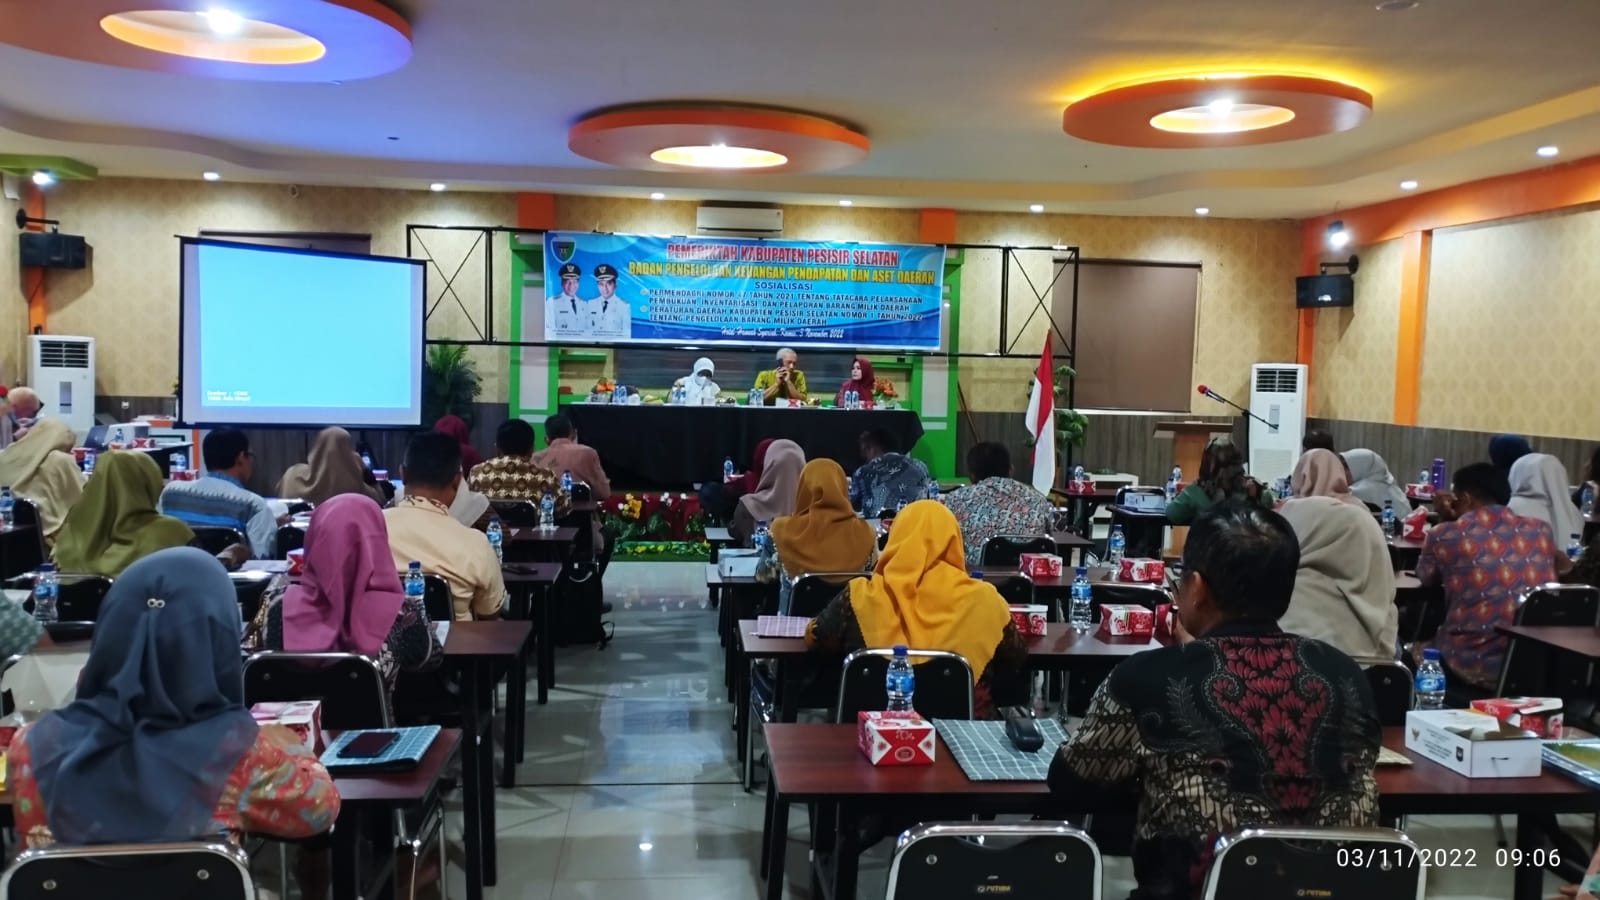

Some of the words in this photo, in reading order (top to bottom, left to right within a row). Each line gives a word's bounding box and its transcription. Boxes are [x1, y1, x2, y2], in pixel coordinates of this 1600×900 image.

[741, 245, 805, 263] KABUPATEN
[807, 248, 850, 265] PESISIR
[853, 250, 899, 266] SELATAN
[629, 261, 662, 275] BADAN
[734, 264, 786, 280] KEUANGAN
[788, 267, 848, 282] PENDAPATAN
[851, 269, 870, 282] DAN
[872, 270, 895, 284] ASET
[897, 271, 935, 285] DAERAH
[755, 281, 813, 291] SOSIALISASI
[706, 290, 735, 298] NOMOR
[797, 293, 830, 301] TENTANG
[832, 294, 868, 302] TATACARA
[871, 295, 923, 304] PELAKSANAAN
[762, 300, 777, 308] DAN
[779, 301, 824, 309] PELAPORAN
[825, 302, 855, 310] BARANG
[857, 303, 878, 311] MILIK
[649, 306, 695, 314] PERATURAN
[696, 307, 727, 315] DAERAH
[729, 308, 773, 316] KABUPATEN
[775, 309, 804, 317] PESISIR
[806, 310, 839, 318] SELATAN
[841, 311, 868, 319] NOMOR
[685, 315, 739, 323] PENGELOLAAN
[741, 316, 771, 324] BARANG
[773, 317, 795, 325] MILIK
[797, 318, 827, 326] DAERAH
